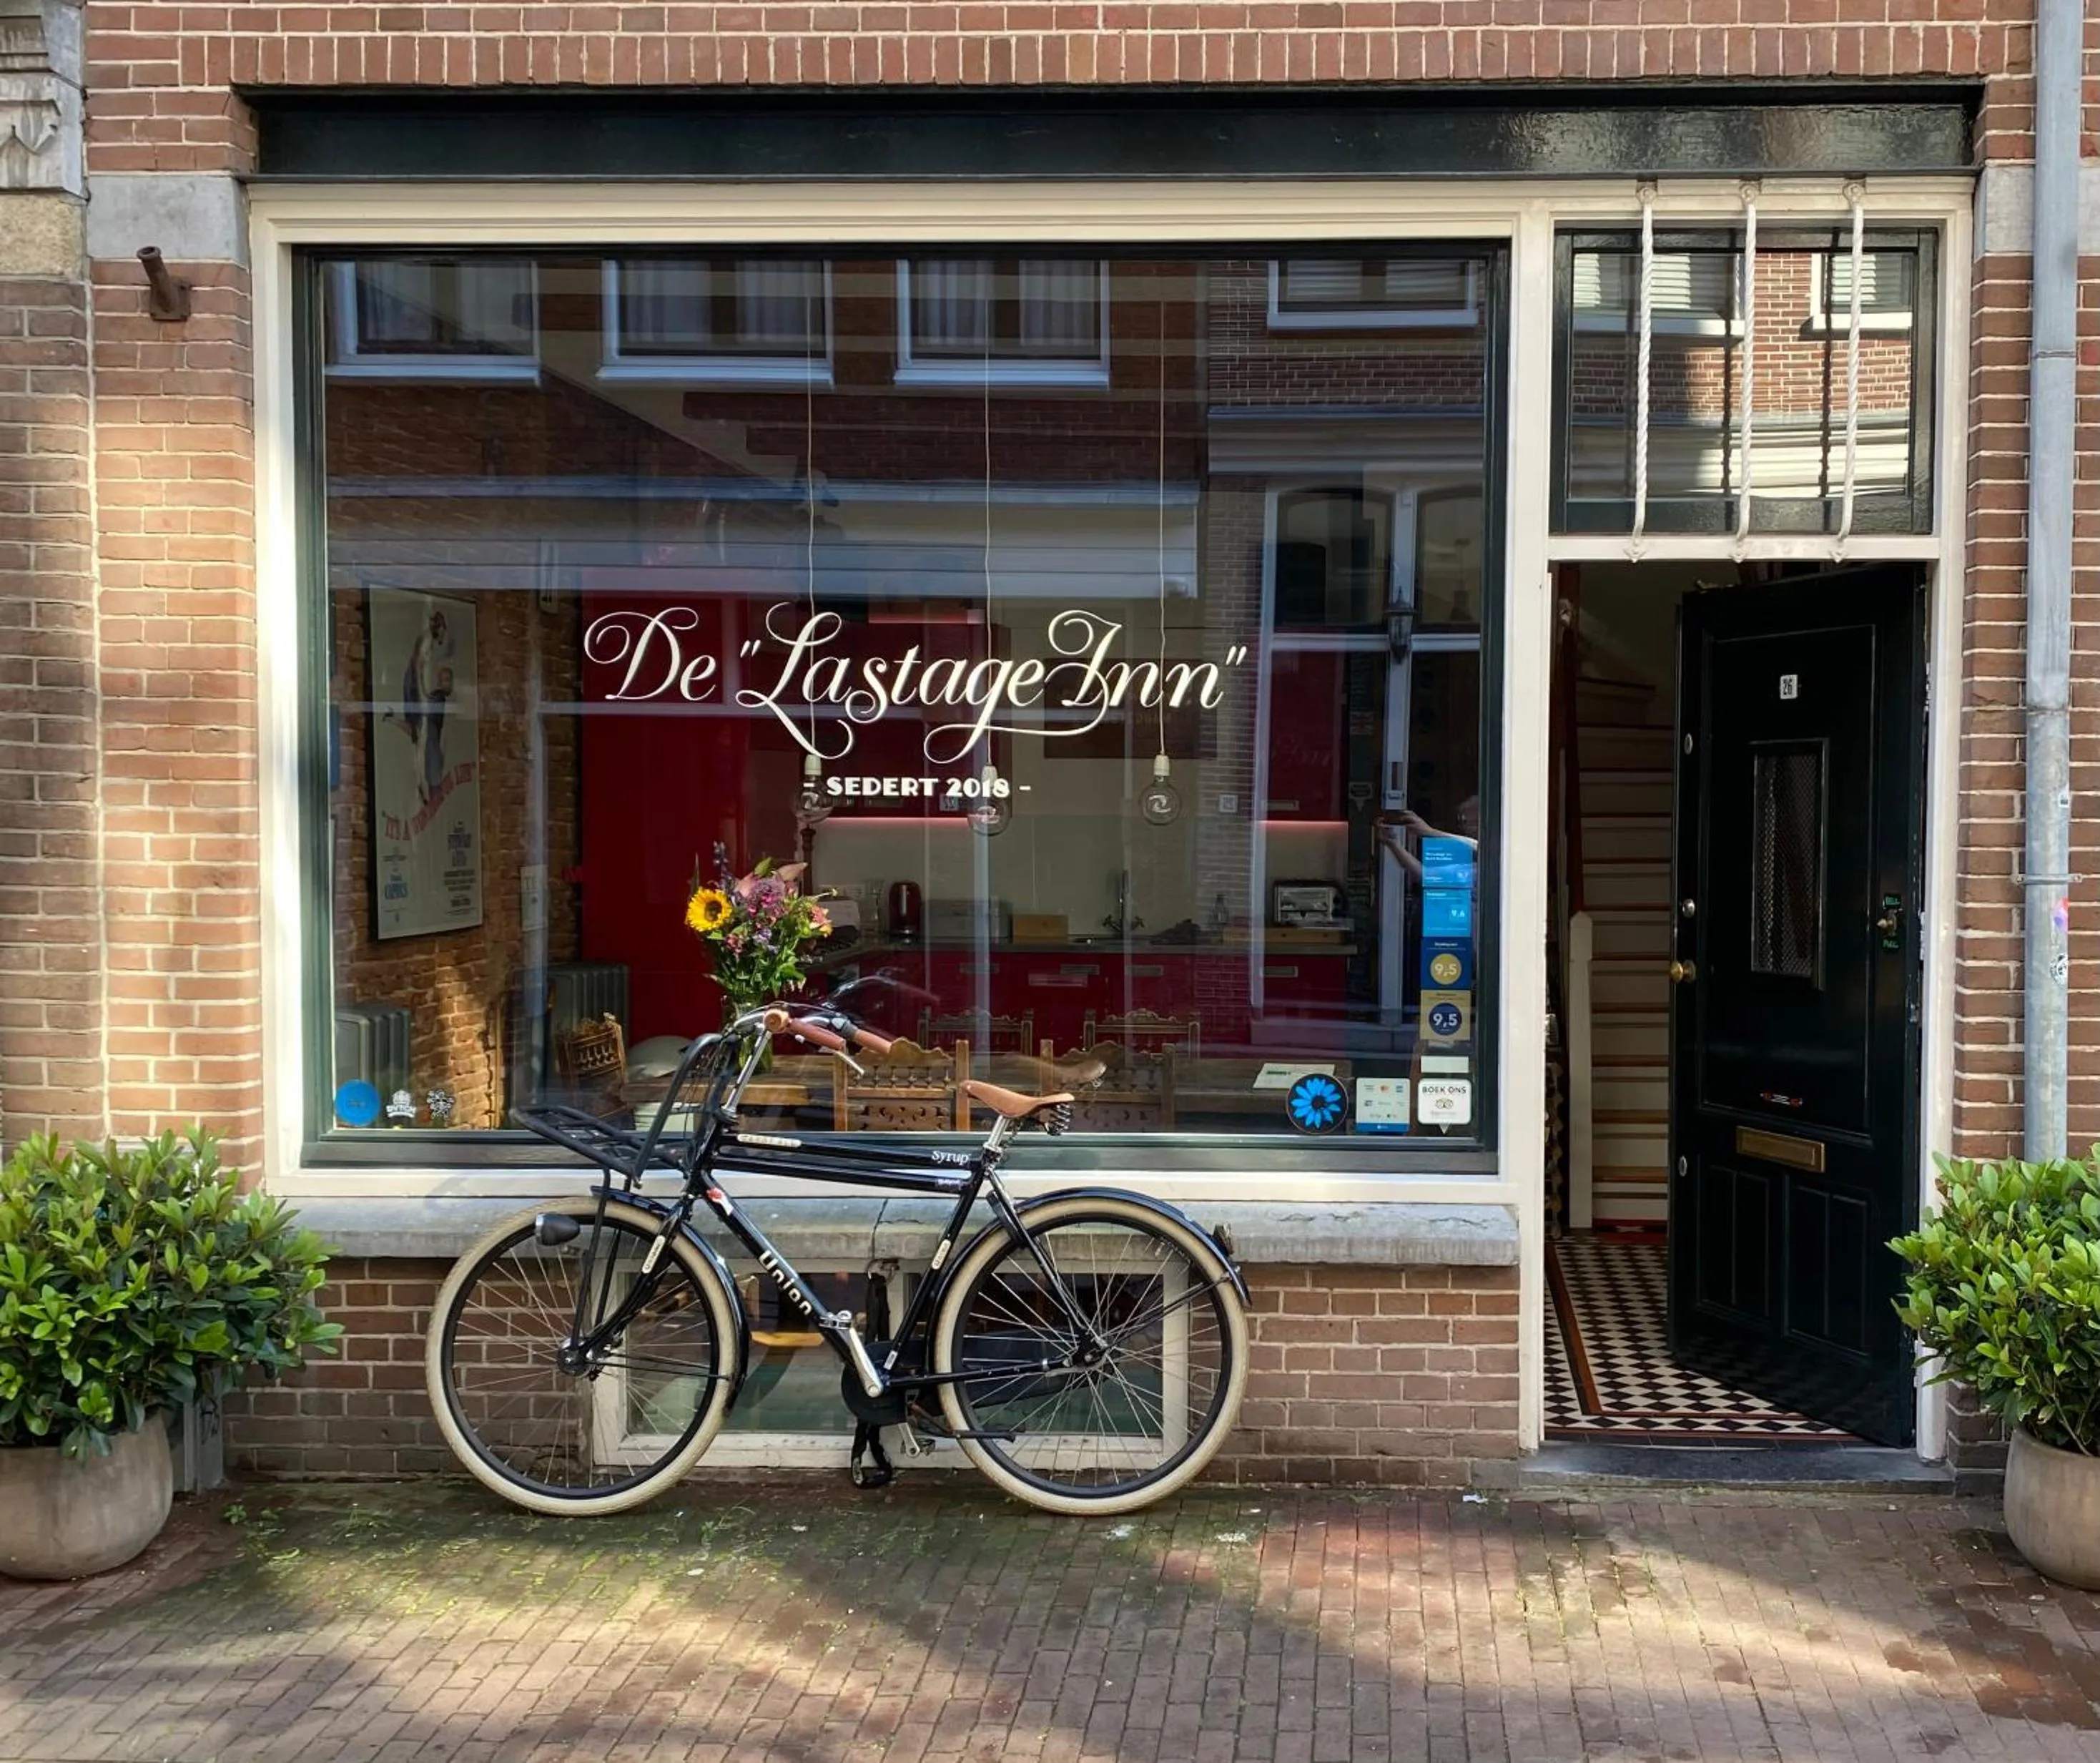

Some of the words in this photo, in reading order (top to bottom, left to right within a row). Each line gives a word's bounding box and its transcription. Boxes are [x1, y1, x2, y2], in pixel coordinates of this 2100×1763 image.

[583, 607, 716, 700] De
[826, 777, 939, 797] SEDERT
[945, 777, 1010, 797] 2018
[1432, 1013, 1458, 1028] 9,5
[1421, 1086, 1446, 1094] BOEK
[1447, 1086, 1467, 1094] ONS
[932, 1150, 970, 1166] Syrup
[758, 1249, 813, 1316] Union
